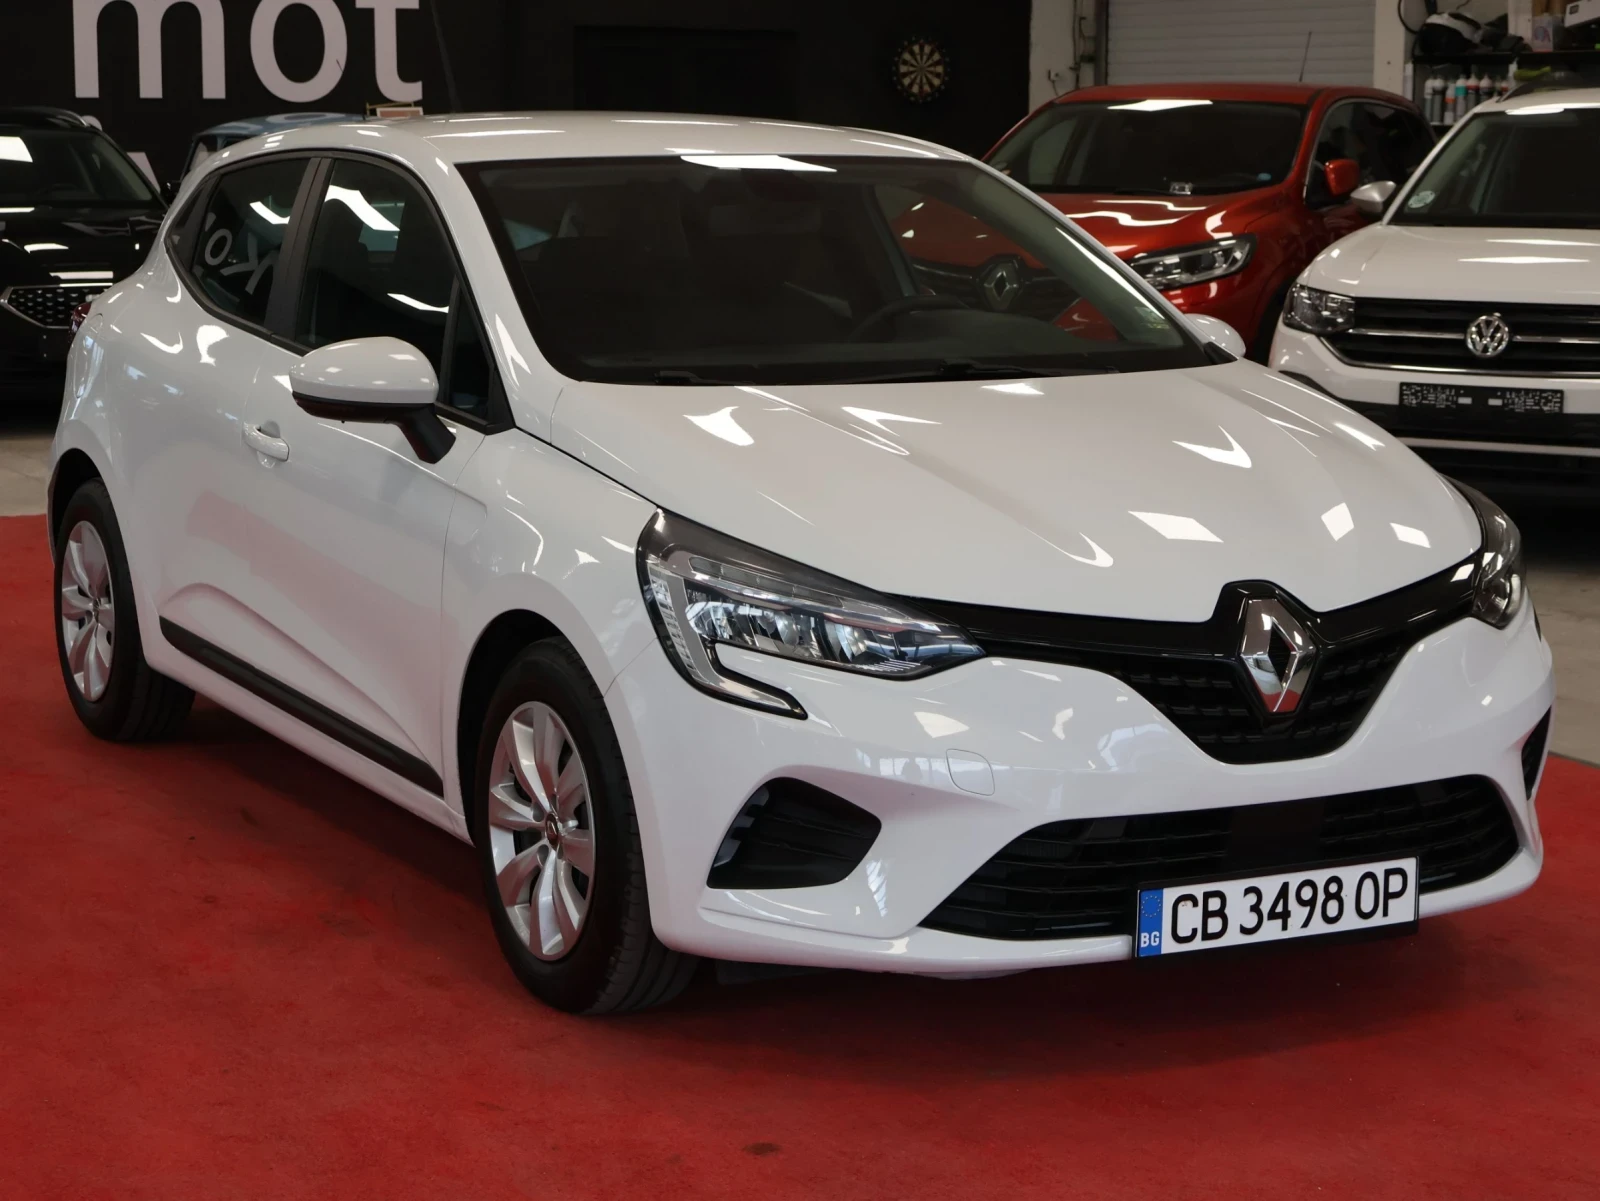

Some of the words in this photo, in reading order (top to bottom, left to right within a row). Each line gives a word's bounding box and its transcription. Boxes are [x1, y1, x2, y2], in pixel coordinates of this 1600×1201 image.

[1171, 890, 1229, 944] CB
[1239, 875, 1344, 936] 3498
[1354, 867, 1409, 920] OP
[1140, 931, 1160, 948] BG
